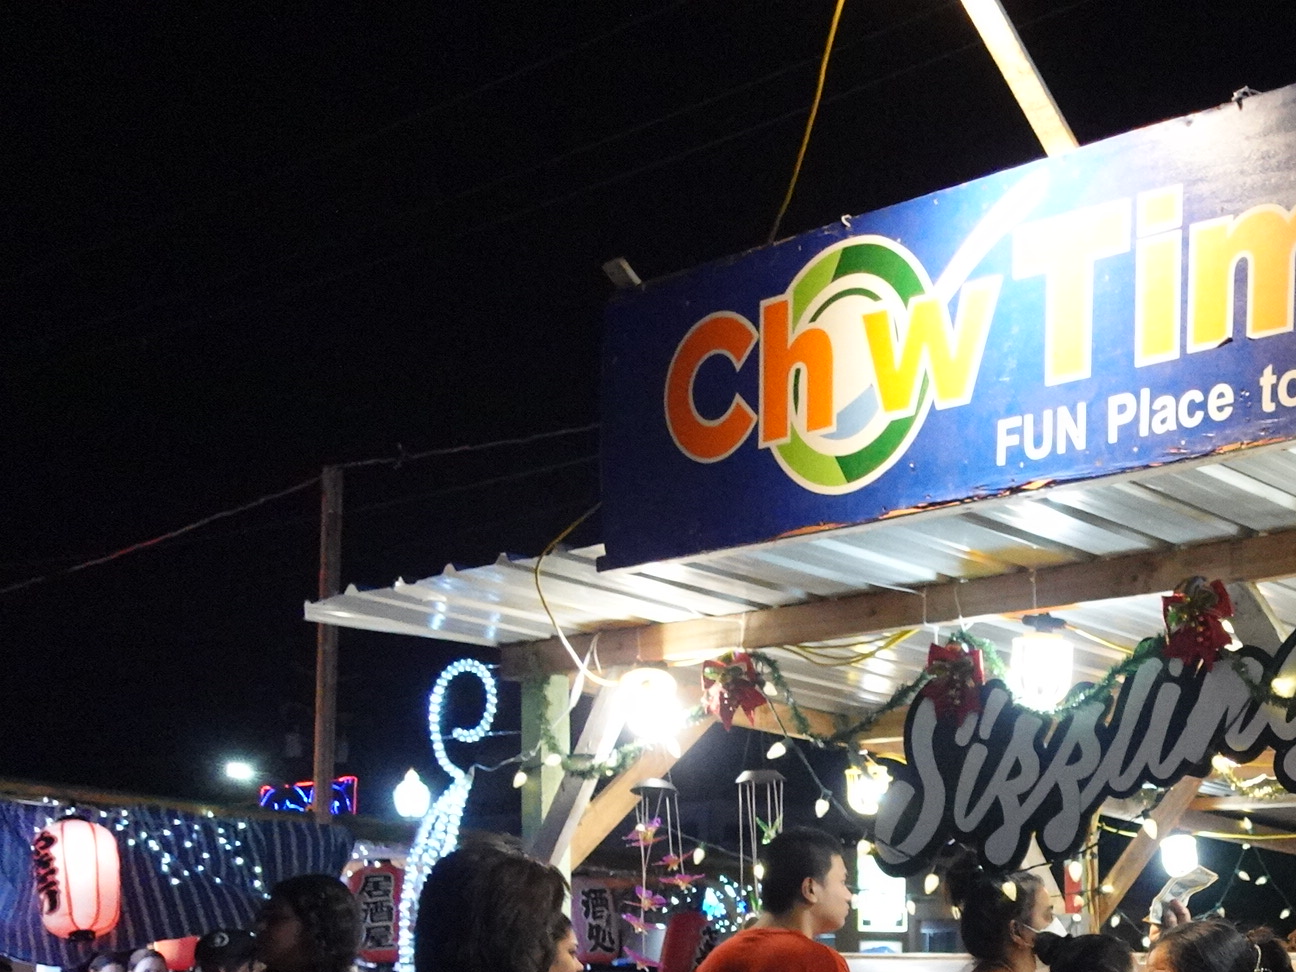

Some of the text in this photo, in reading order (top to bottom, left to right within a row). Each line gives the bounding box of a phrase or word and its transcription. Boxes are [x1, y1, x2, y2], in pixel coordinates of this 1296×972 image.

[996, 402, 1087, 466] FUN
[1108, 383, 1235, 444] Place
[360, 873, 394, 949] 居酒屋
